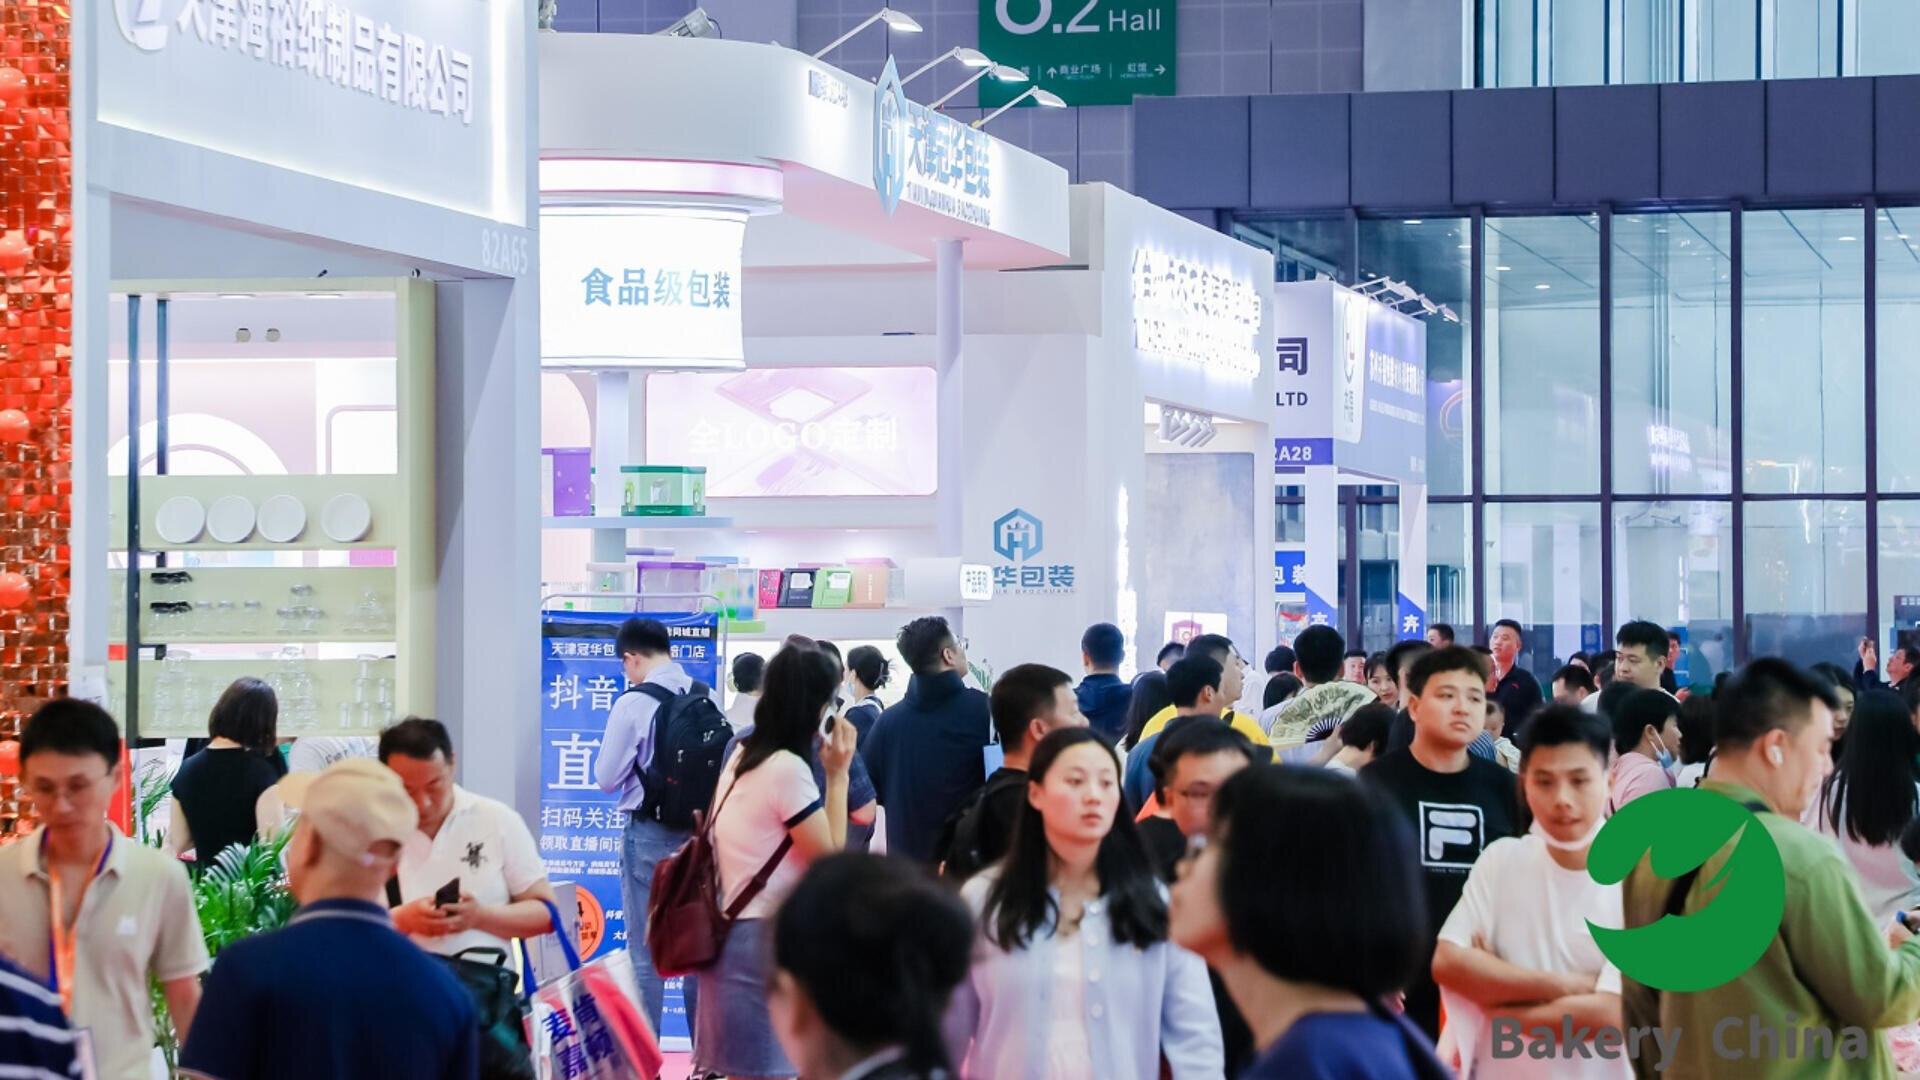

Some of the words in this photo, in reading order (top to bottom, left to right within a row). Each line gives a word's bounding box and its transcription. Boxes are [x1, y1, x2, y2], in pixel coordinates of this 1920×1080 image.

[1108, 8, 1160, 32] Hall
[482, 228, 528, 276] 82A65
[581, 267, 731, 309] 食品级包装
[1276, 337, 1308, 375] 司
[1275, 392, 1308, 406] LTD
[1275, 446, 1312, 461] A28
[548, 733, 601, 790] 直
[541, 806, 625, 829] 扫码关注
